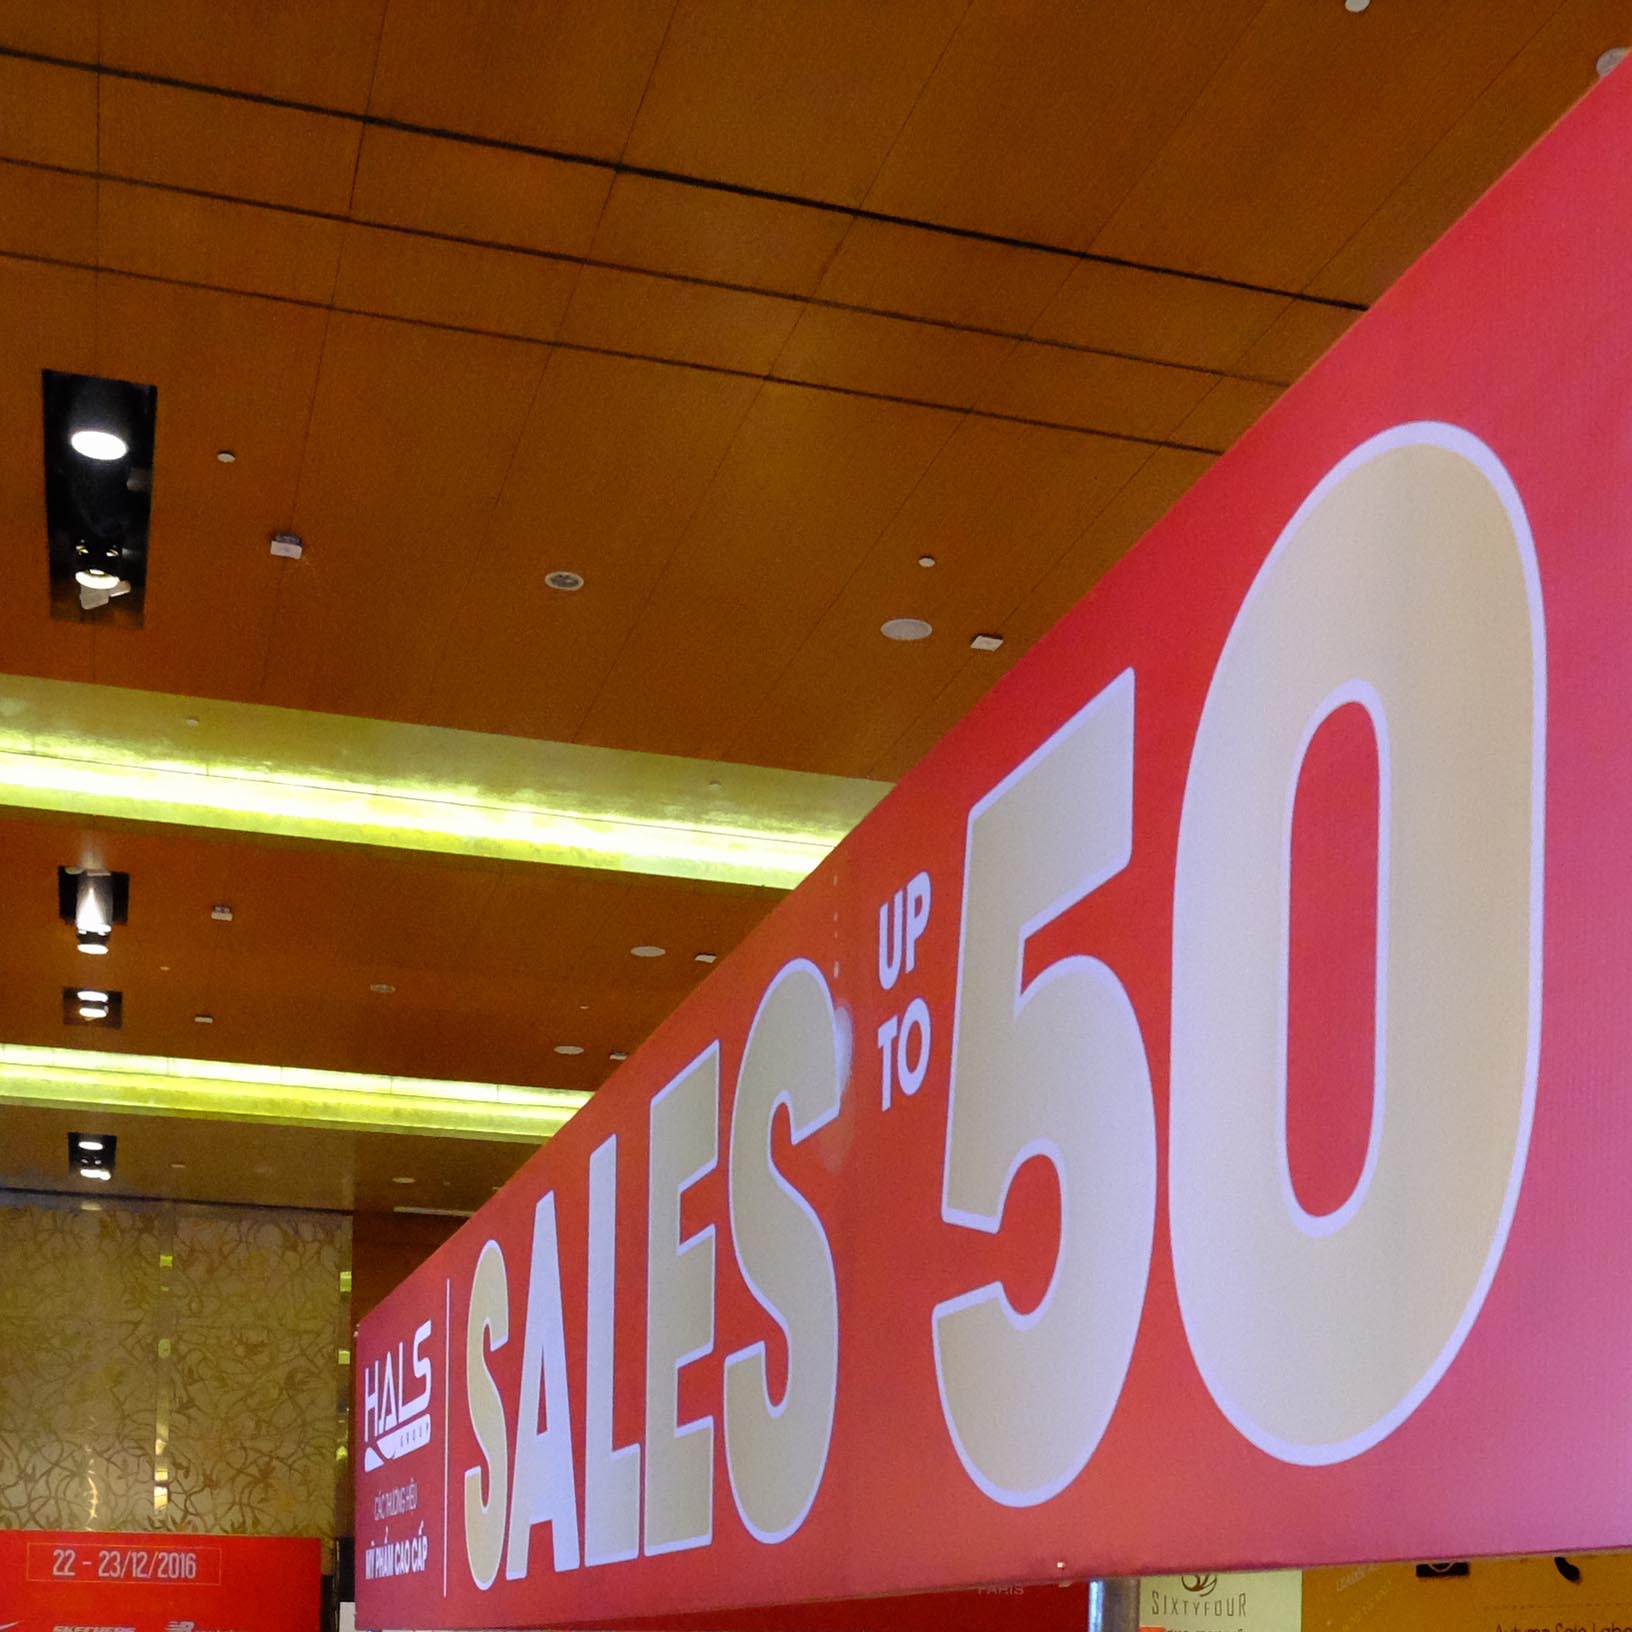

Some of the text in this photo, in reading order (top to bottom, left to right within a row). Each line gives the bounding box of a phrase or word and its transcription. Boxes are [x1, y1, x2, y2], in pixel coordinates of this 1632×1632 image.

[878, 871, 932, 990] UP
[877, 997, 931, 1113] TO
[464, 957, 842, 1593] SALES
[364, 1319, 432, 1443] HALS
[52, 1549, 77, 1577] 22
[98, 1549, 197, 1579] 23/12/2016
[394, 1538, 411, 1576] CAO
[1152, 1590, 1248, 1617] SIXTYFOUR
